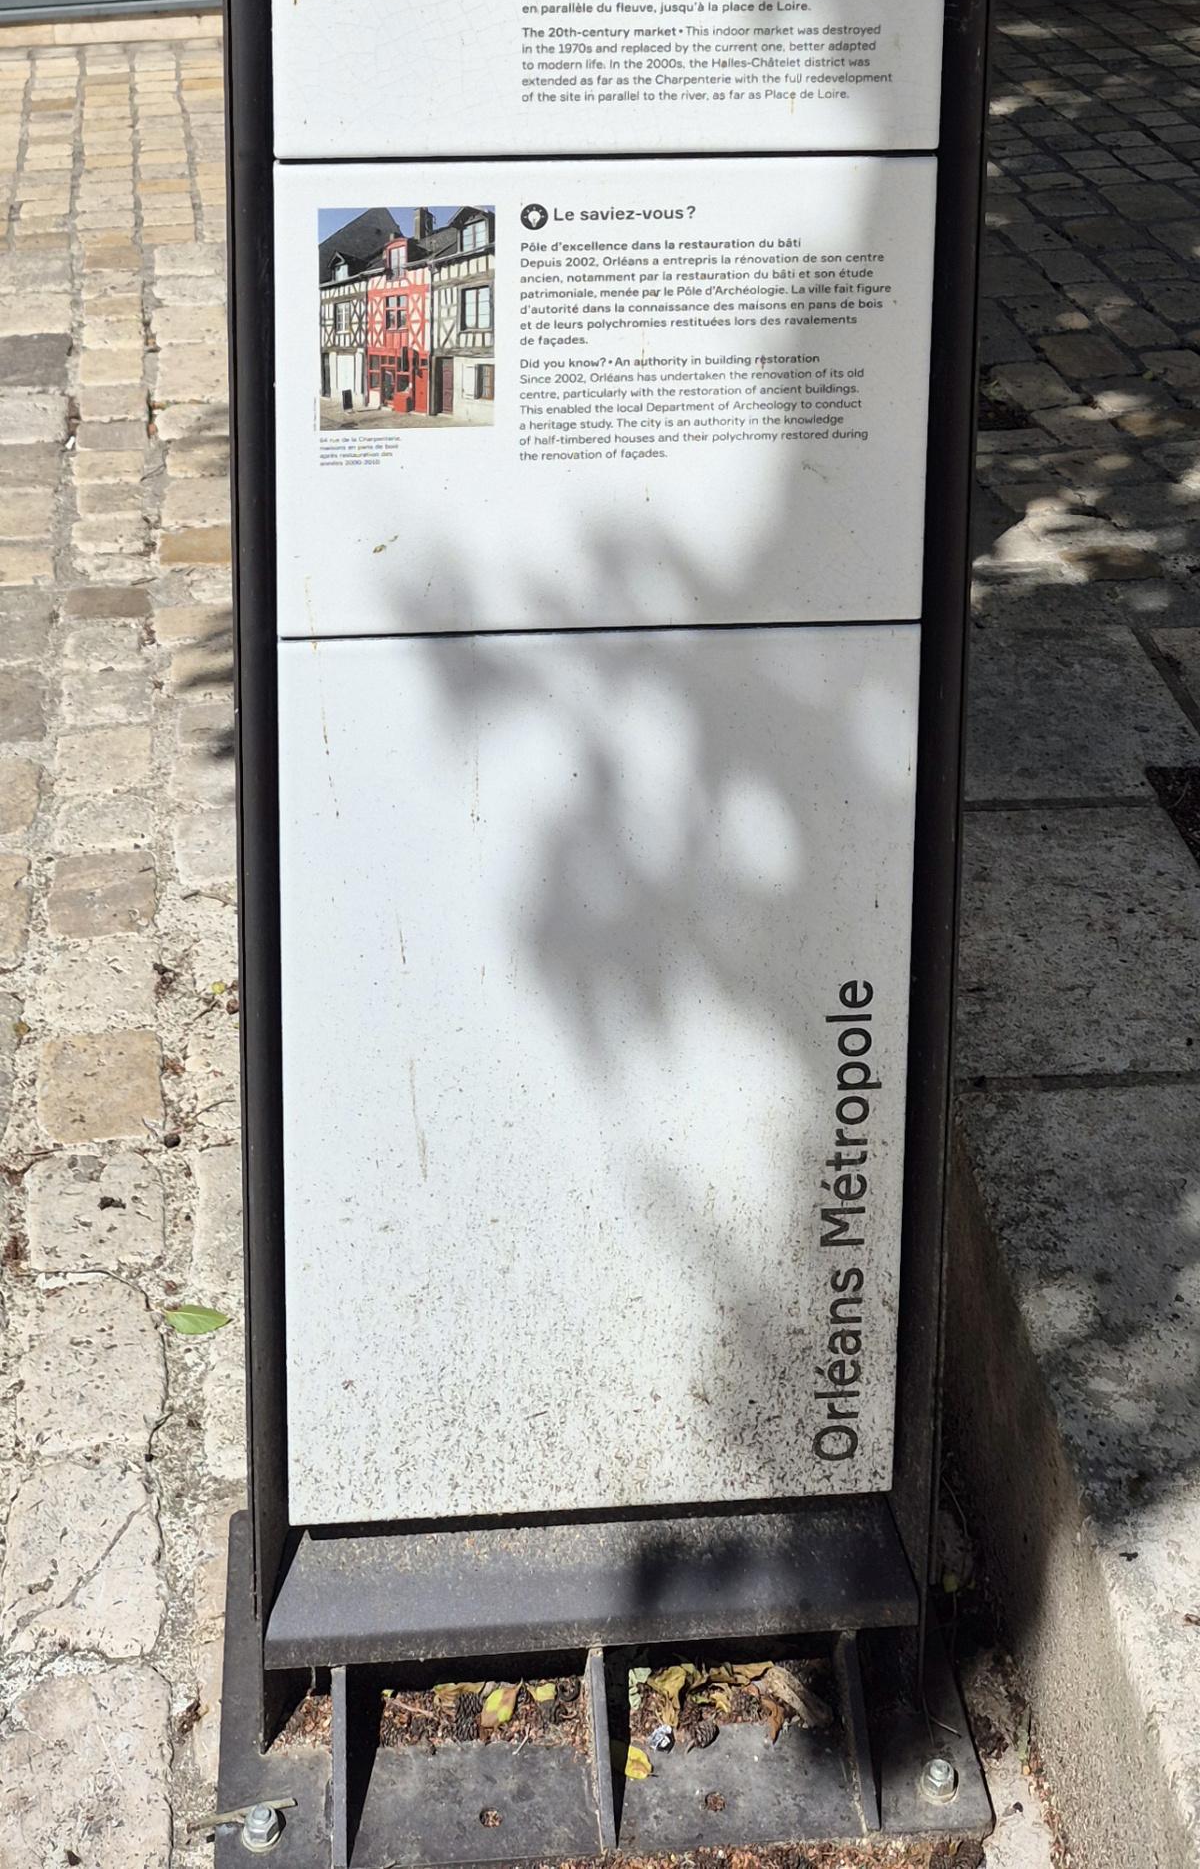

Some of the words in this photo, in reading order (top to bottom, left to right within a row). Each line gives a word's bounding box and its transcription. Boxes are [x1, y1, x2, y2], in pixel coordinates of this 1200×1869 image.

[521, 5, 539, 13] en
[540, 2, 593, 15] parallèle
[596, 2, 612, 13] du
[615, 1, 657, 16] fleuve,
[659, 1, 705, 14] jusqu'à
[707, 2, 718, 11] la
[722, 1, 755, 13] place
[758, 0, 773, 11] de
[776, 0, 811, 11] Loire.
[521, 27, 545, 38] The
[547, 26, 630, 39] 20th-century
[633, 26, 676, 36] market
[685, 25, 709, 36] This
[712, 26, 750, 36] indoor
[753, 25, 794, 35] market
[797, 27, 819, 35] was
[821, 24, 881, 37] destroyed
[553, 207, 574, 221] Le
[520, 242, 547, 252] Pôle
[550, 240, 628, 251] d'excellence
[631, 240, 661, 250] dans
[664, 239, 675, 249] la
[678, 238, 755, 249] restauration
[758, 238, 774, 248] du
[777, 237, 801, 248] bâti
[520, 257, 562, 269] Depuis
[565, 256, 599, 267] 2002,
[602, 255, 649, 266] Orléans
[662, 254, 718, 267] entrepris
[720, 254, 731, 264] la
[734, 253, 799, 264] rénovation
[802, 253, 817, 263] de
[820, 255, 842, 263] son
[845, 253, 884, 262] centre
[519, 358, 539, 368] Did
[543, 360, 565, 370] you
[568, 357, 606, 367] know?
[614, 356, 630, 366] An
[633, 355, 687, 368] authority
[690, 355, 701, 365] in
[704, 354, 751, 367] building
[754, 354, 820, 364] restoration
[519, 451, 538, 461] the
[541, 449, 602, 460] renovation
[605, 448, 617, 458] of
[821, 979, 882, 1248] Métropole
[812, 1266, 864, 1463] Orléans
